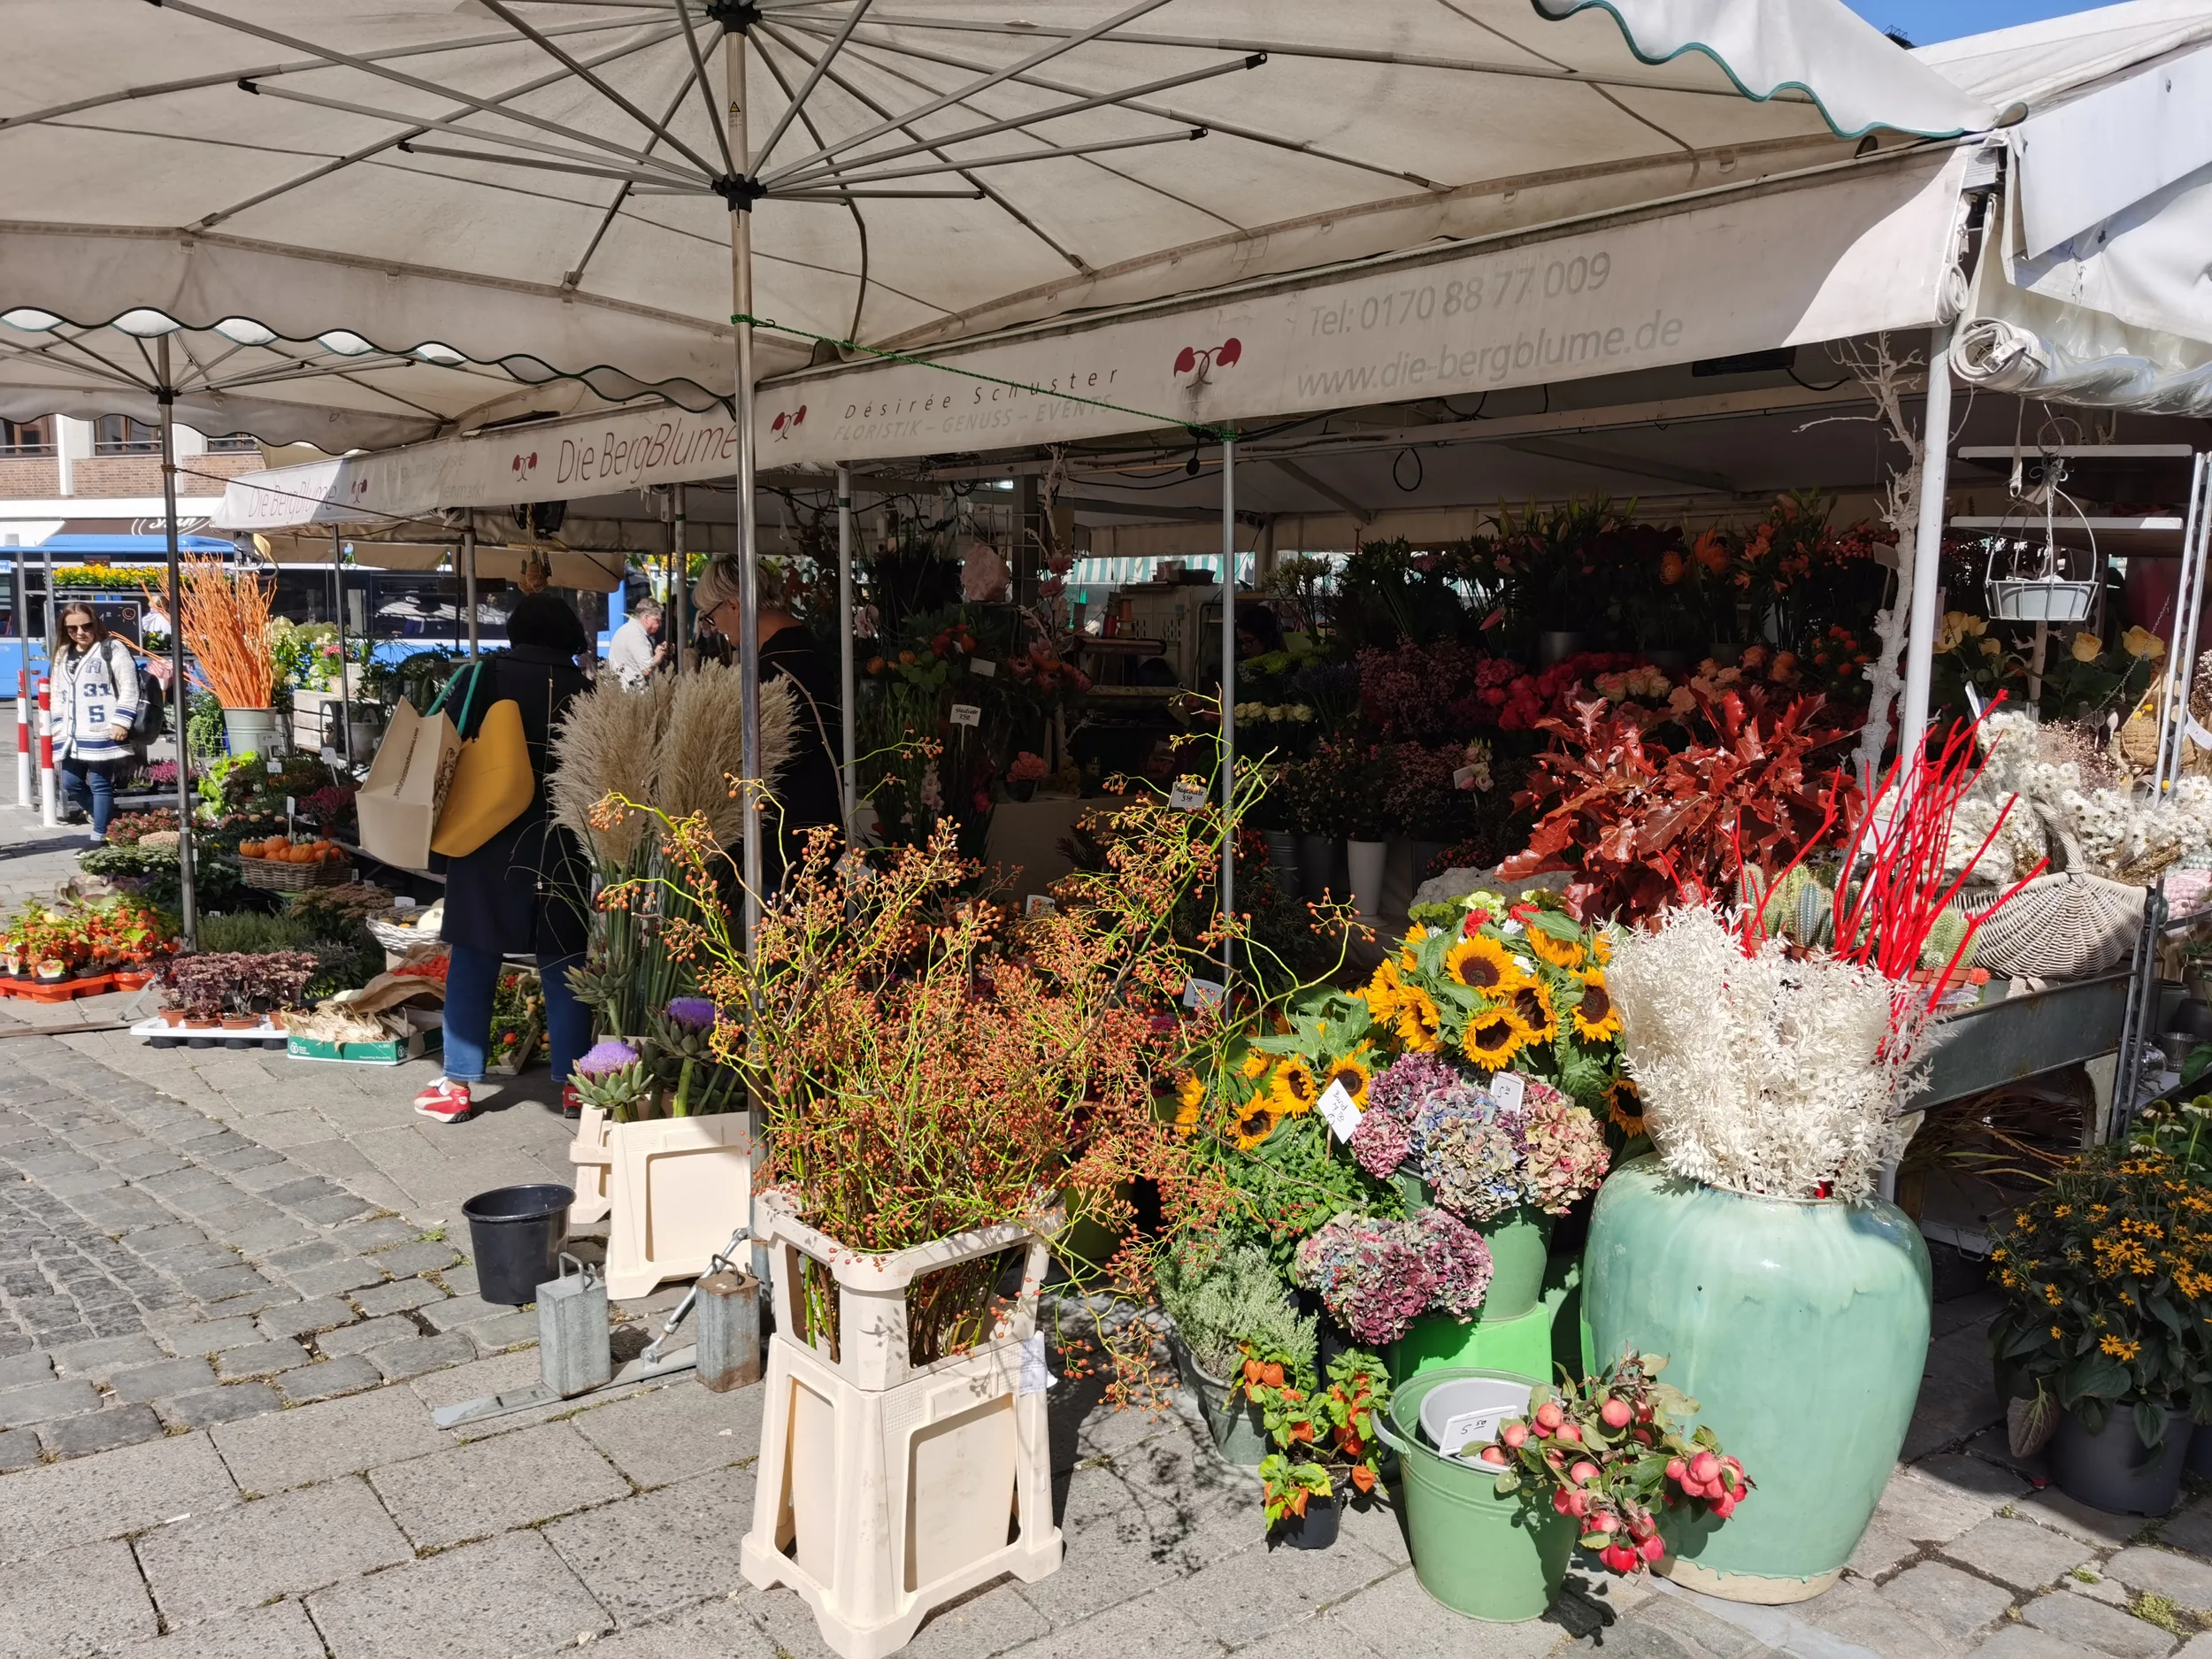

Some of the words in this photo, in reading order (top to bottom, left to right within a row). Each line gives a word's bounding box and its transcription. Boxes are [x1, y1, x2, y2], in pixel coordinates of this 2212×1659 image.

[1310, 302, 1354, 337] Tel:
[1360, 285, 1436, 330] 0170
[1442, 276, 1483, 317] 88
[1493, 265, 1538, 305] 77
[1543, 250, 1611, 298] 009
[1297, 310, 1683, 397] www.die-bergblume.de
[833, 420, 921, 442] FLORISTIK
[942, 409, 1011, 434] GENUSS
[1034, 393, 1112, 424] EVENTS
[845, 391, 952, 420] Désirée
[974, 368, 1118, 404] Schuster
[556, 437, 594, 484] Die
[600, 418, 738, 483] BergBlume
[88, 704, 105, 723] 5
